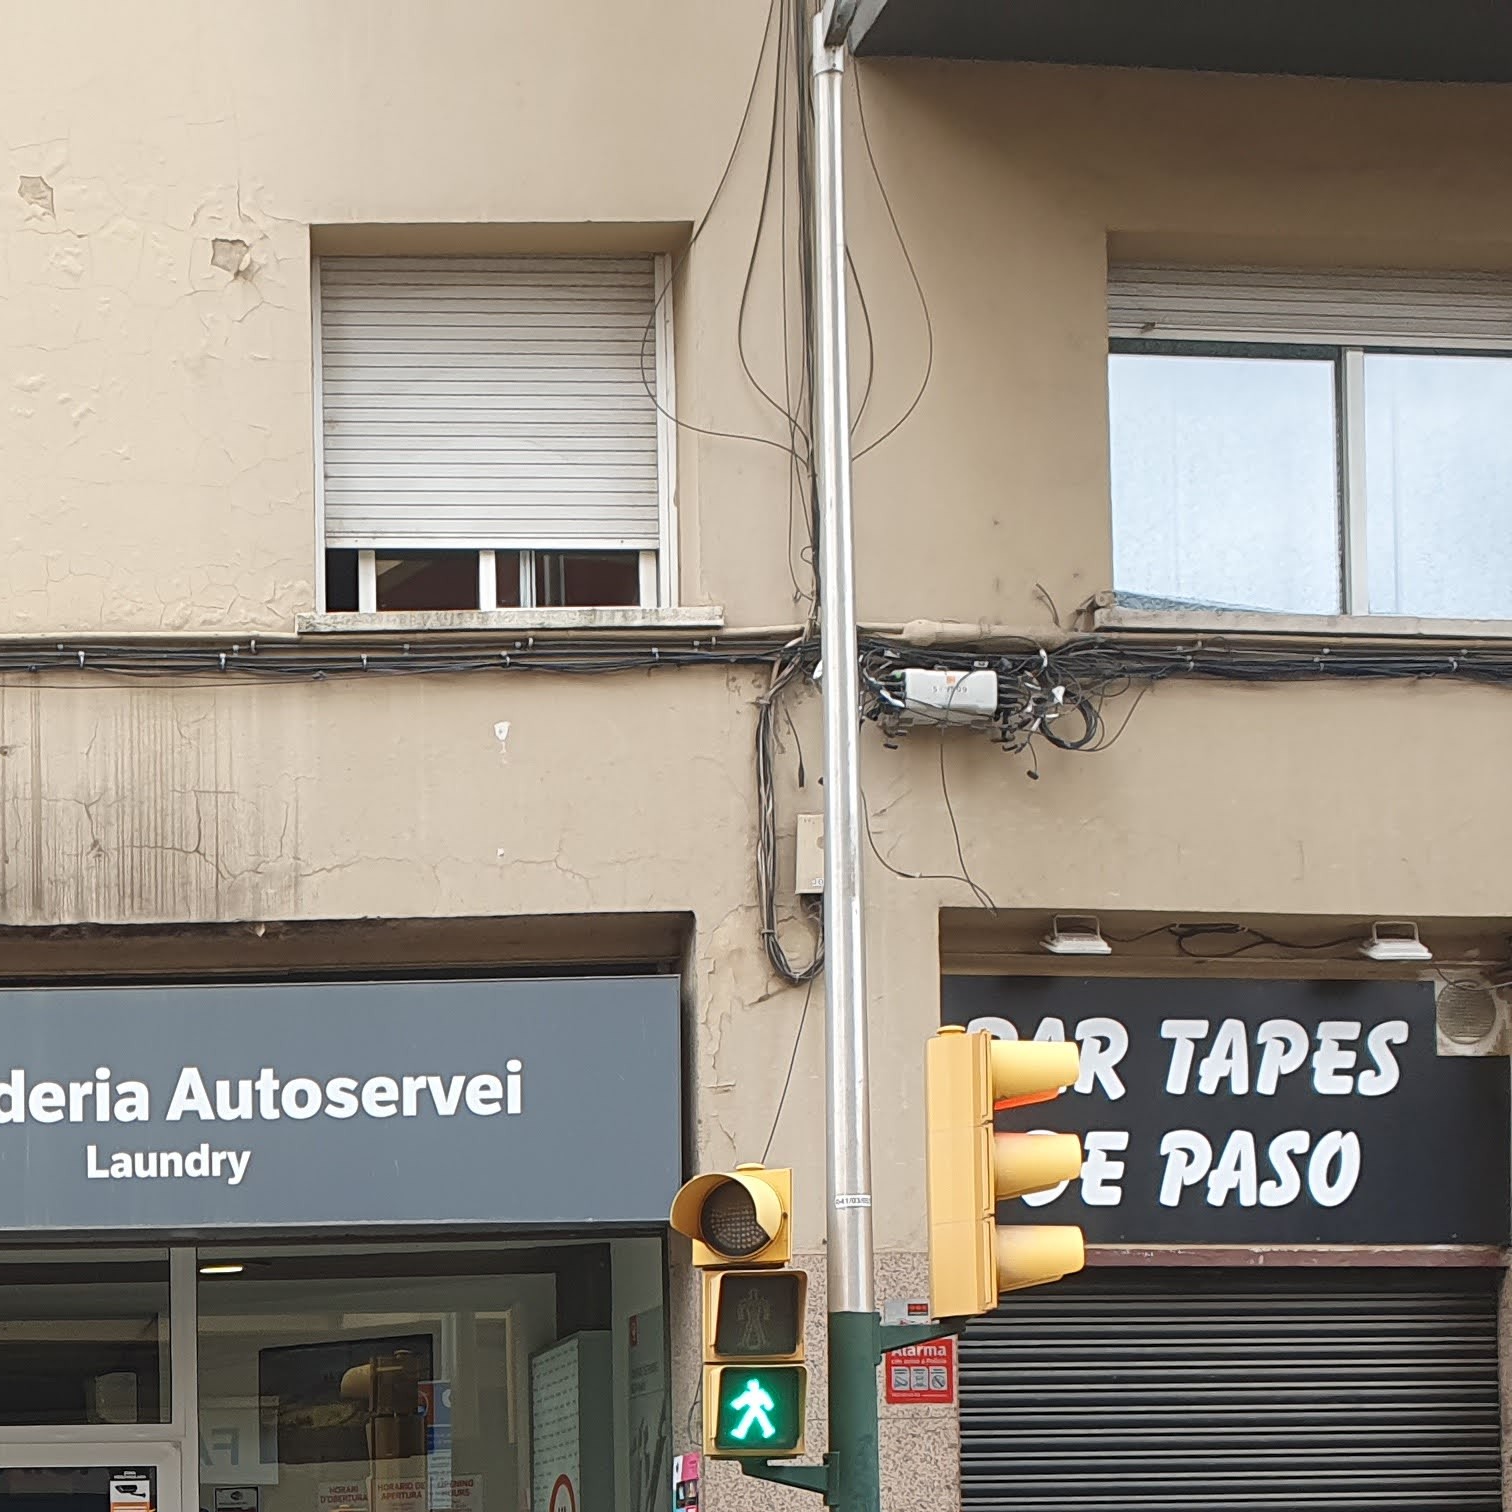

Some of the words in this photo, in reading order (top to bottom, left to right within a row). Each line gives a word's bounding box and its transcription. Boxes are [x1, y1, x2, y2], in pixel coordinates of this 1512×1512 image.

[165, 1059, 522, 1121] Autoservei
[1160, 1018, 1409, 1096] TAPES
[86, 1143, 251, 1185] Laundry
[1159, 1129, 1361, 1207] PASO
